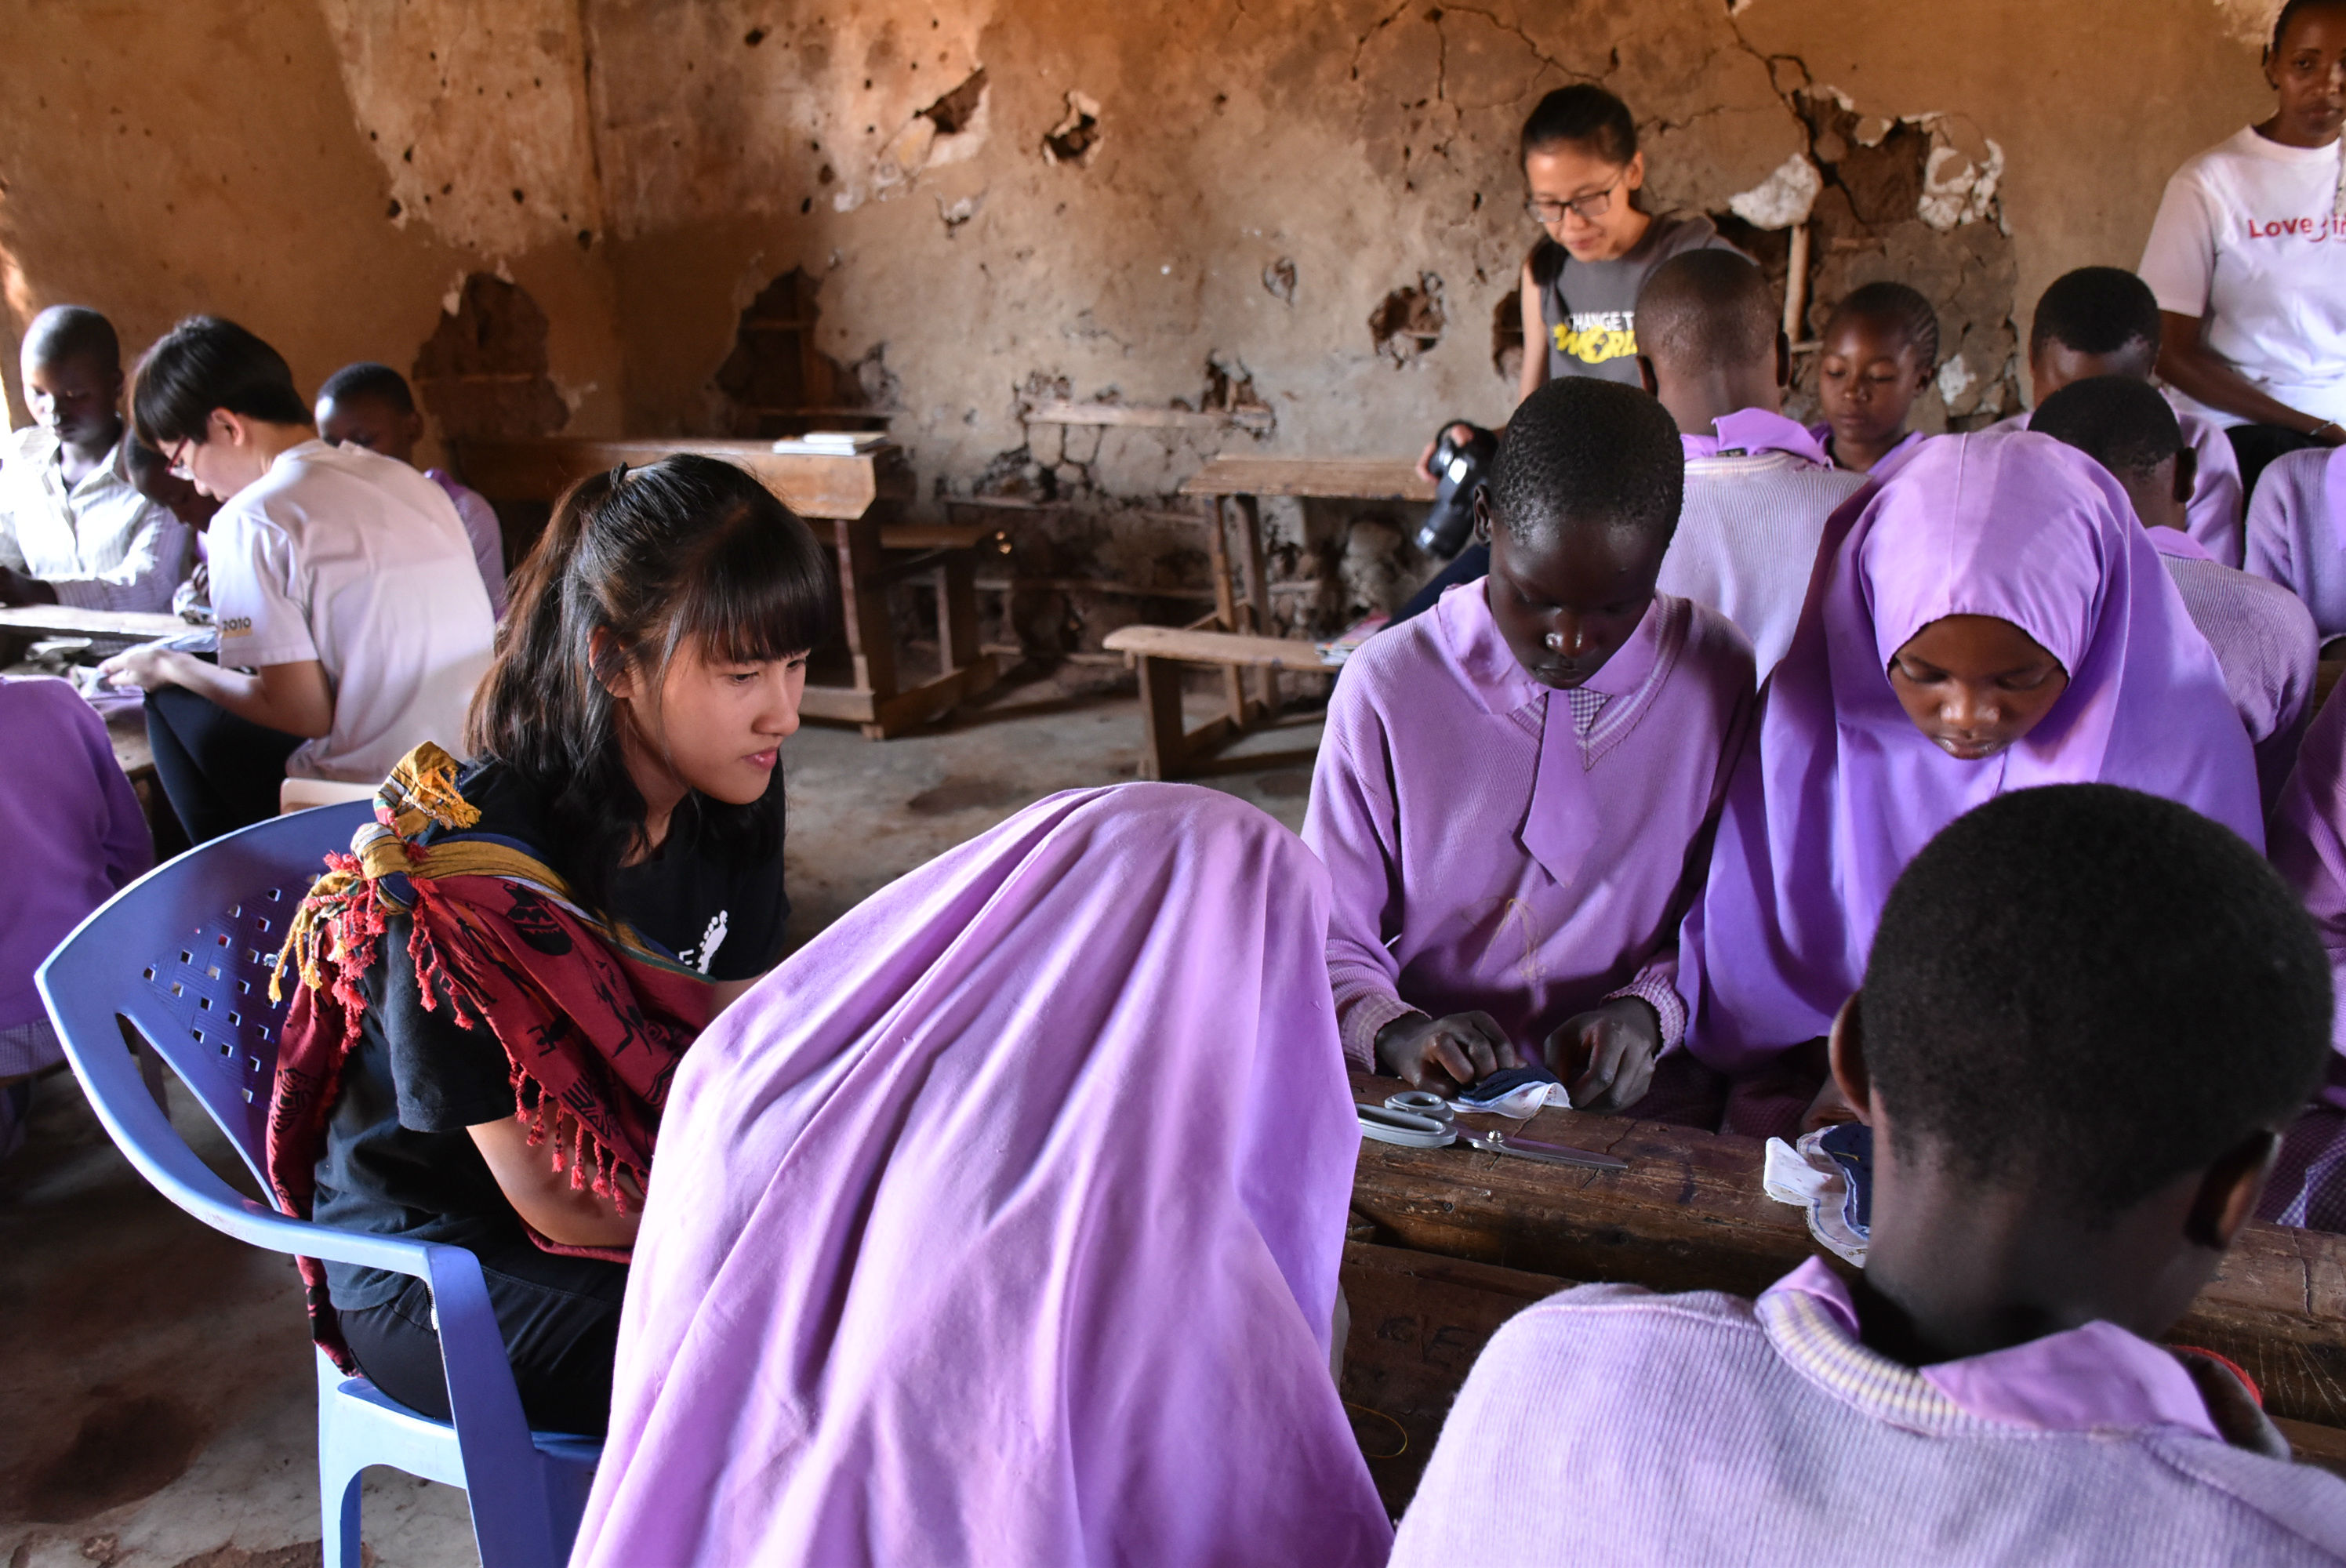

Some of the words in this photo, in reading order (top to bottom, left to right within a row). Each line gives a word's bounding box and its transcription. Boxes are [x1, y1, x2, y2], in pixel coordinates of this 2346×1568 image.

[2248, 217, 2313, 238] Love
[1622, 310, 1636, 331] T
[1553, 322, 1638, 364] WORL
